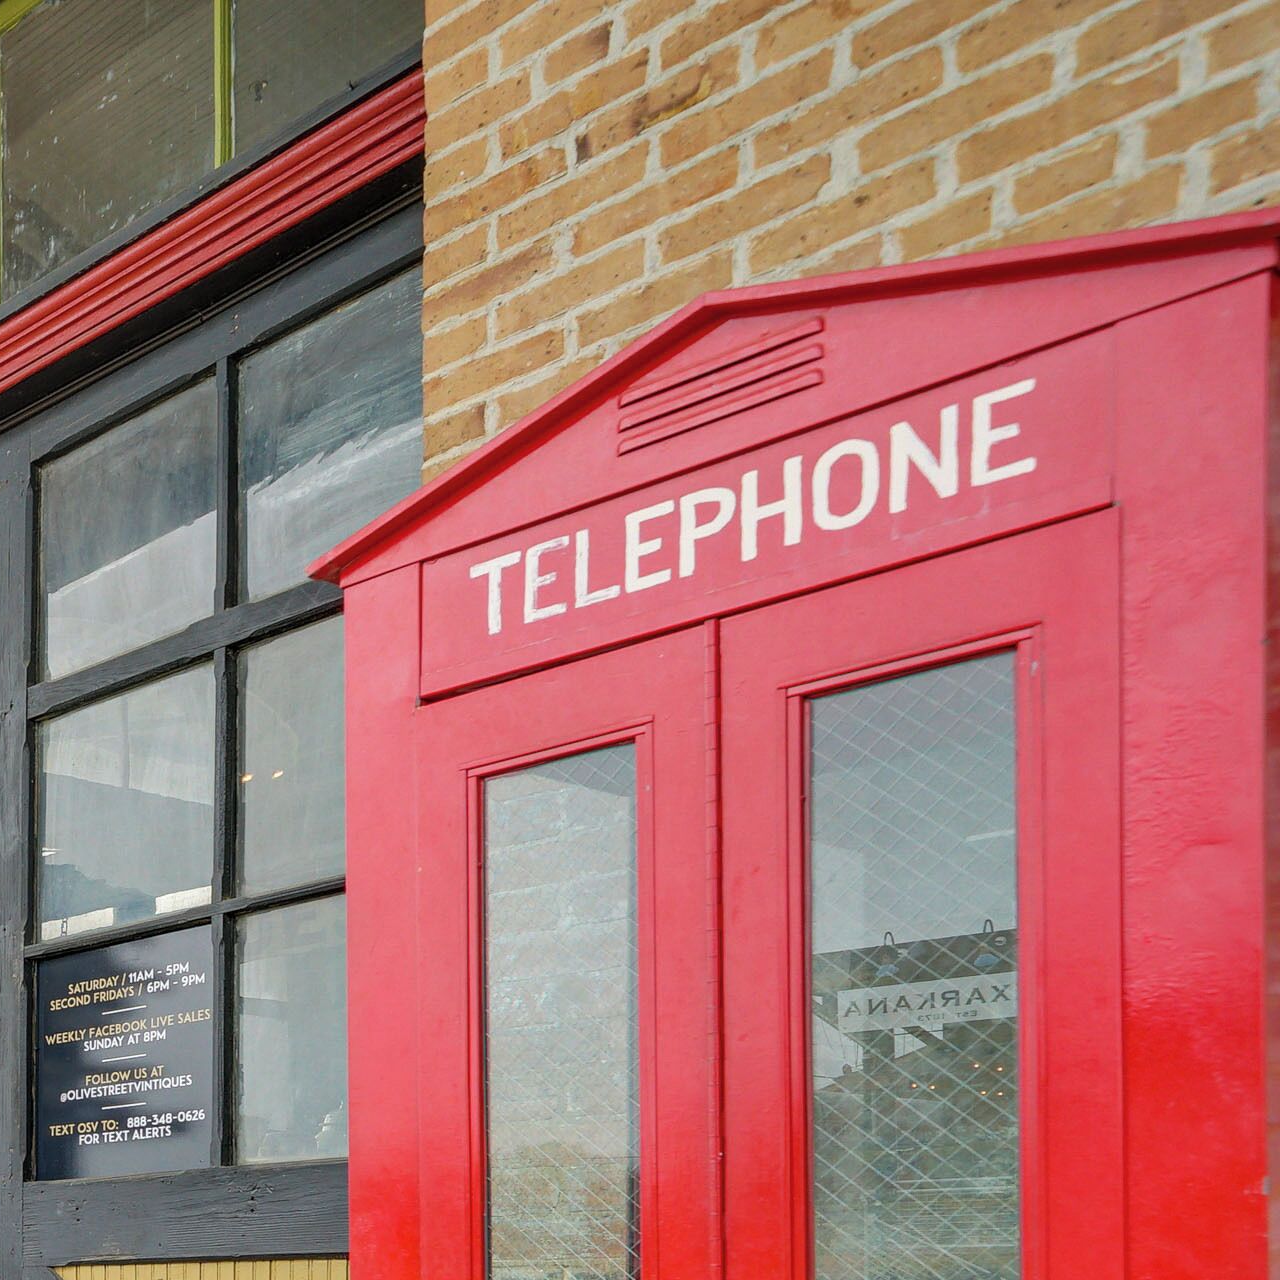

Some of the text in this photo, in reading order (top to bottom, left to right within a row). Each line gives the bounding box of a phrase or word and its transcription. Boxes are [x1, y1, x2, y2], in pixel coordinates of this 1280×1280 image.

[469, 377, 1037, 635] TELEPHONE
[50, 994, 91, 1011] SECOND
[93, 986, 134, 1004] FRIDAYS
[146, 979, 170, 993] 6PM
[181, 973, 205, 987] 9PM
[68, 975, 119, 995] SATURDAY
[128, 968, 154, 983] 11AM
[165, 962, 189, 976] 5PM
[45, 1008, 211, 1046] WEEKLY FACEBOOK LIVE SALES
[83, 1029, 166, 1052] SUNDAY AT 8PM
[60, 1074, 192, 1103] @OLIVESTREETVINTIQUES
[85, 1065, 164, 1086] FOLLOW US AT
[49, 1109, 205, 1137] TEXT OSV TO: 888-348-0626
[78, 1125, 172, 1146] FOR TEXT ALERTS
